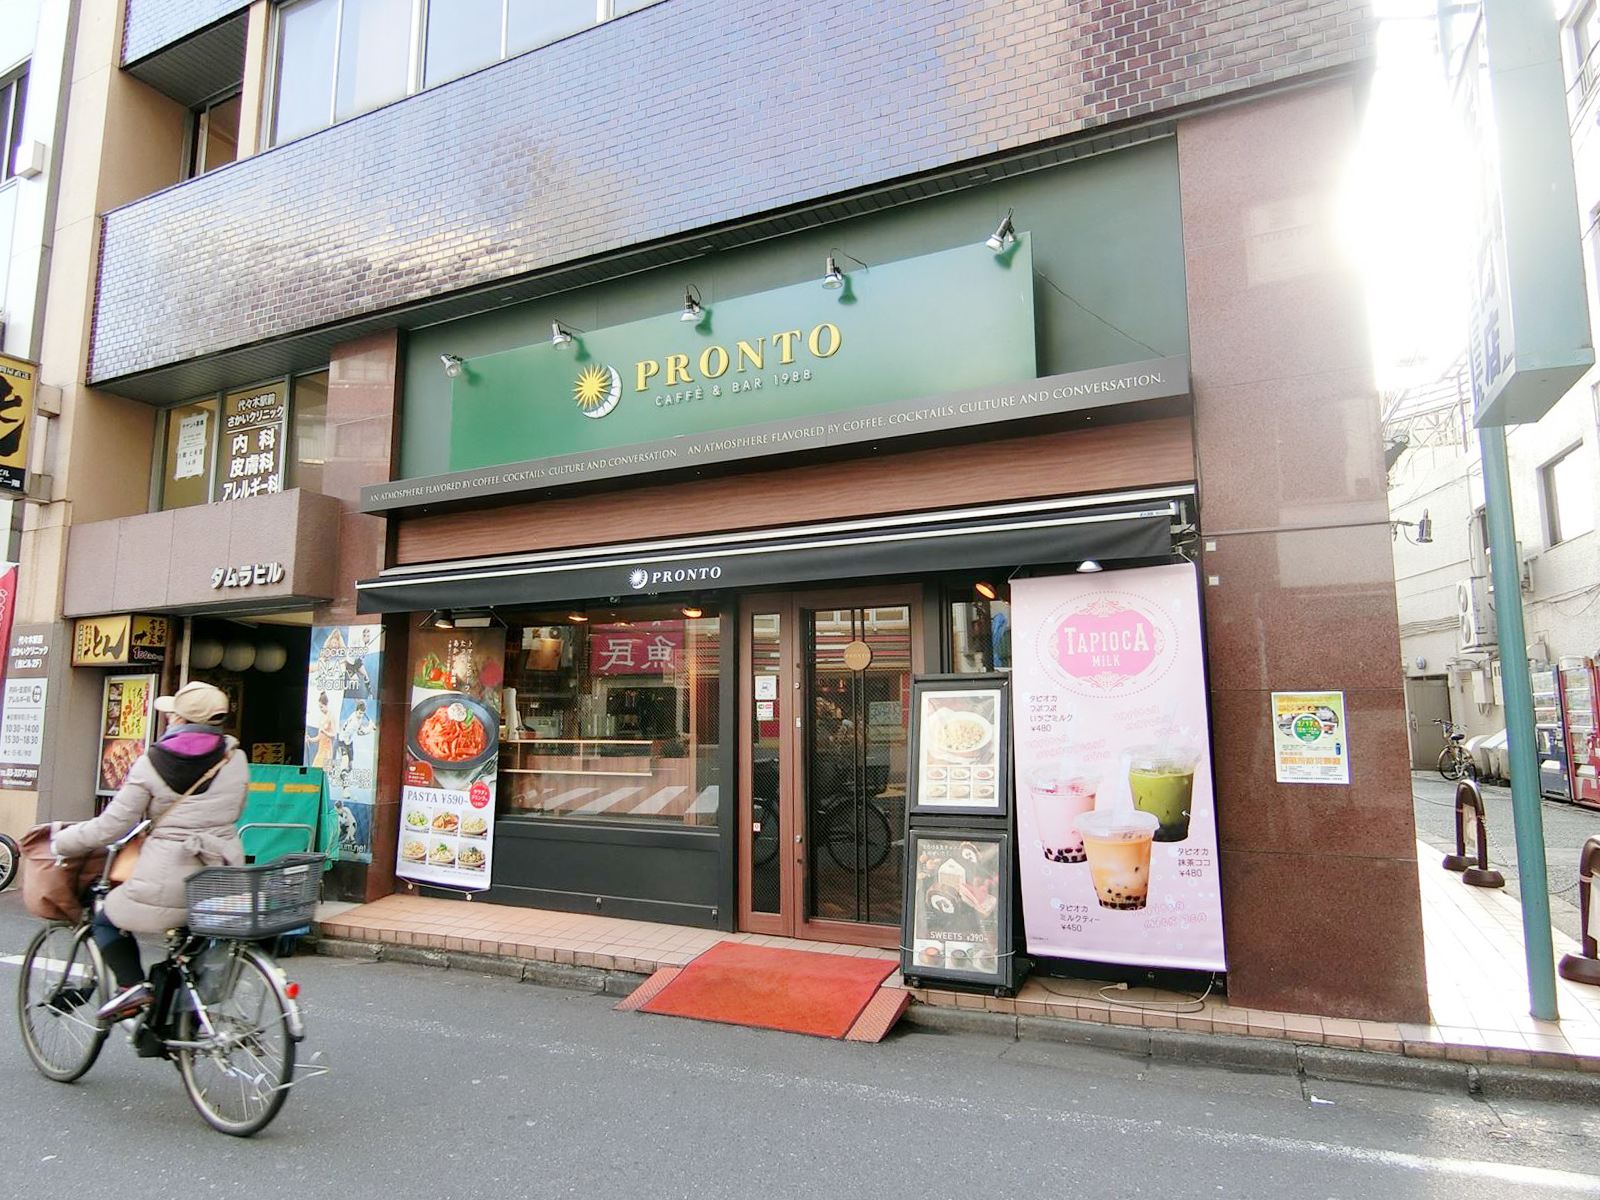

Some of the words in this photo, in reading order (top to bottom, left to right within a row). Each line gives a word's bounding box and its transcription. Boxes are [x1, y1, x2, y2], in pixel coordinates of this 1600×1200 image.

[634, 322, 842, 392] PRONTO
[711, 386, 722, 396] &
[732, 376, 763, 393] BAR
[773, 369, 813, 386] 1988
[237, 392, 276, 411] 代々木駅前
[227, 405, 285, 427] さかいクリニック
[687, 444, 702, 455] AN
[704, 434, 769, 453] ATMOSPHERE
[771, 425, 825, 442] FLAVORED
[827, 422, 841, 434] BY
[959, 396, 1016, 415] CULTURE
[1019, 390, 1049, 405] AND
[1053, 372, 1166, 400] CONVERSATION.
[229, 451, 275, 479] 皮膚科
[370, 494, 380, 502] AN
[380, 486, 424, 500] ATMOSPHERE
[425, 481, 461, 494] FLAVORED
[462, 479, 473, 489] BY
[548, 462, 585, 476] CULTURE
[586, 459, 606, 471] AND
[222, 474, 280, 502] アレルギー科
[211, 562, 285, 589] タムラビル
[651, 566, 722, 584] PRONTO
[1064, 623, 1150, 655] TAPIOCA
[319, 647, 346, 658] HOCKEY
[348, 646, 369, 657] SHOP
[1092, 654, 1120, 667] MILK
[317, 677, 359, 690] Stadium
[1029, 695, 1058, 703] タピオカ
[1029, 714, 1073, 722] いちごミルク
[1030, 724, 1052, 732] ¥480
[407, 790, 438, 803] PASTA
[1177, 847, 1209, 856] タピオカ
[1178, 858, 1211, 867] 抹茶ココ
[1179, 869, 1203, 877] ¥480
[1059, 904, 1089, 913] タピオカ
[1060, 914, 1100, 924] ミルクティー
[1061, 923, 1082, 932] ¥450
[930, 931, 963, 941] SWEETS
